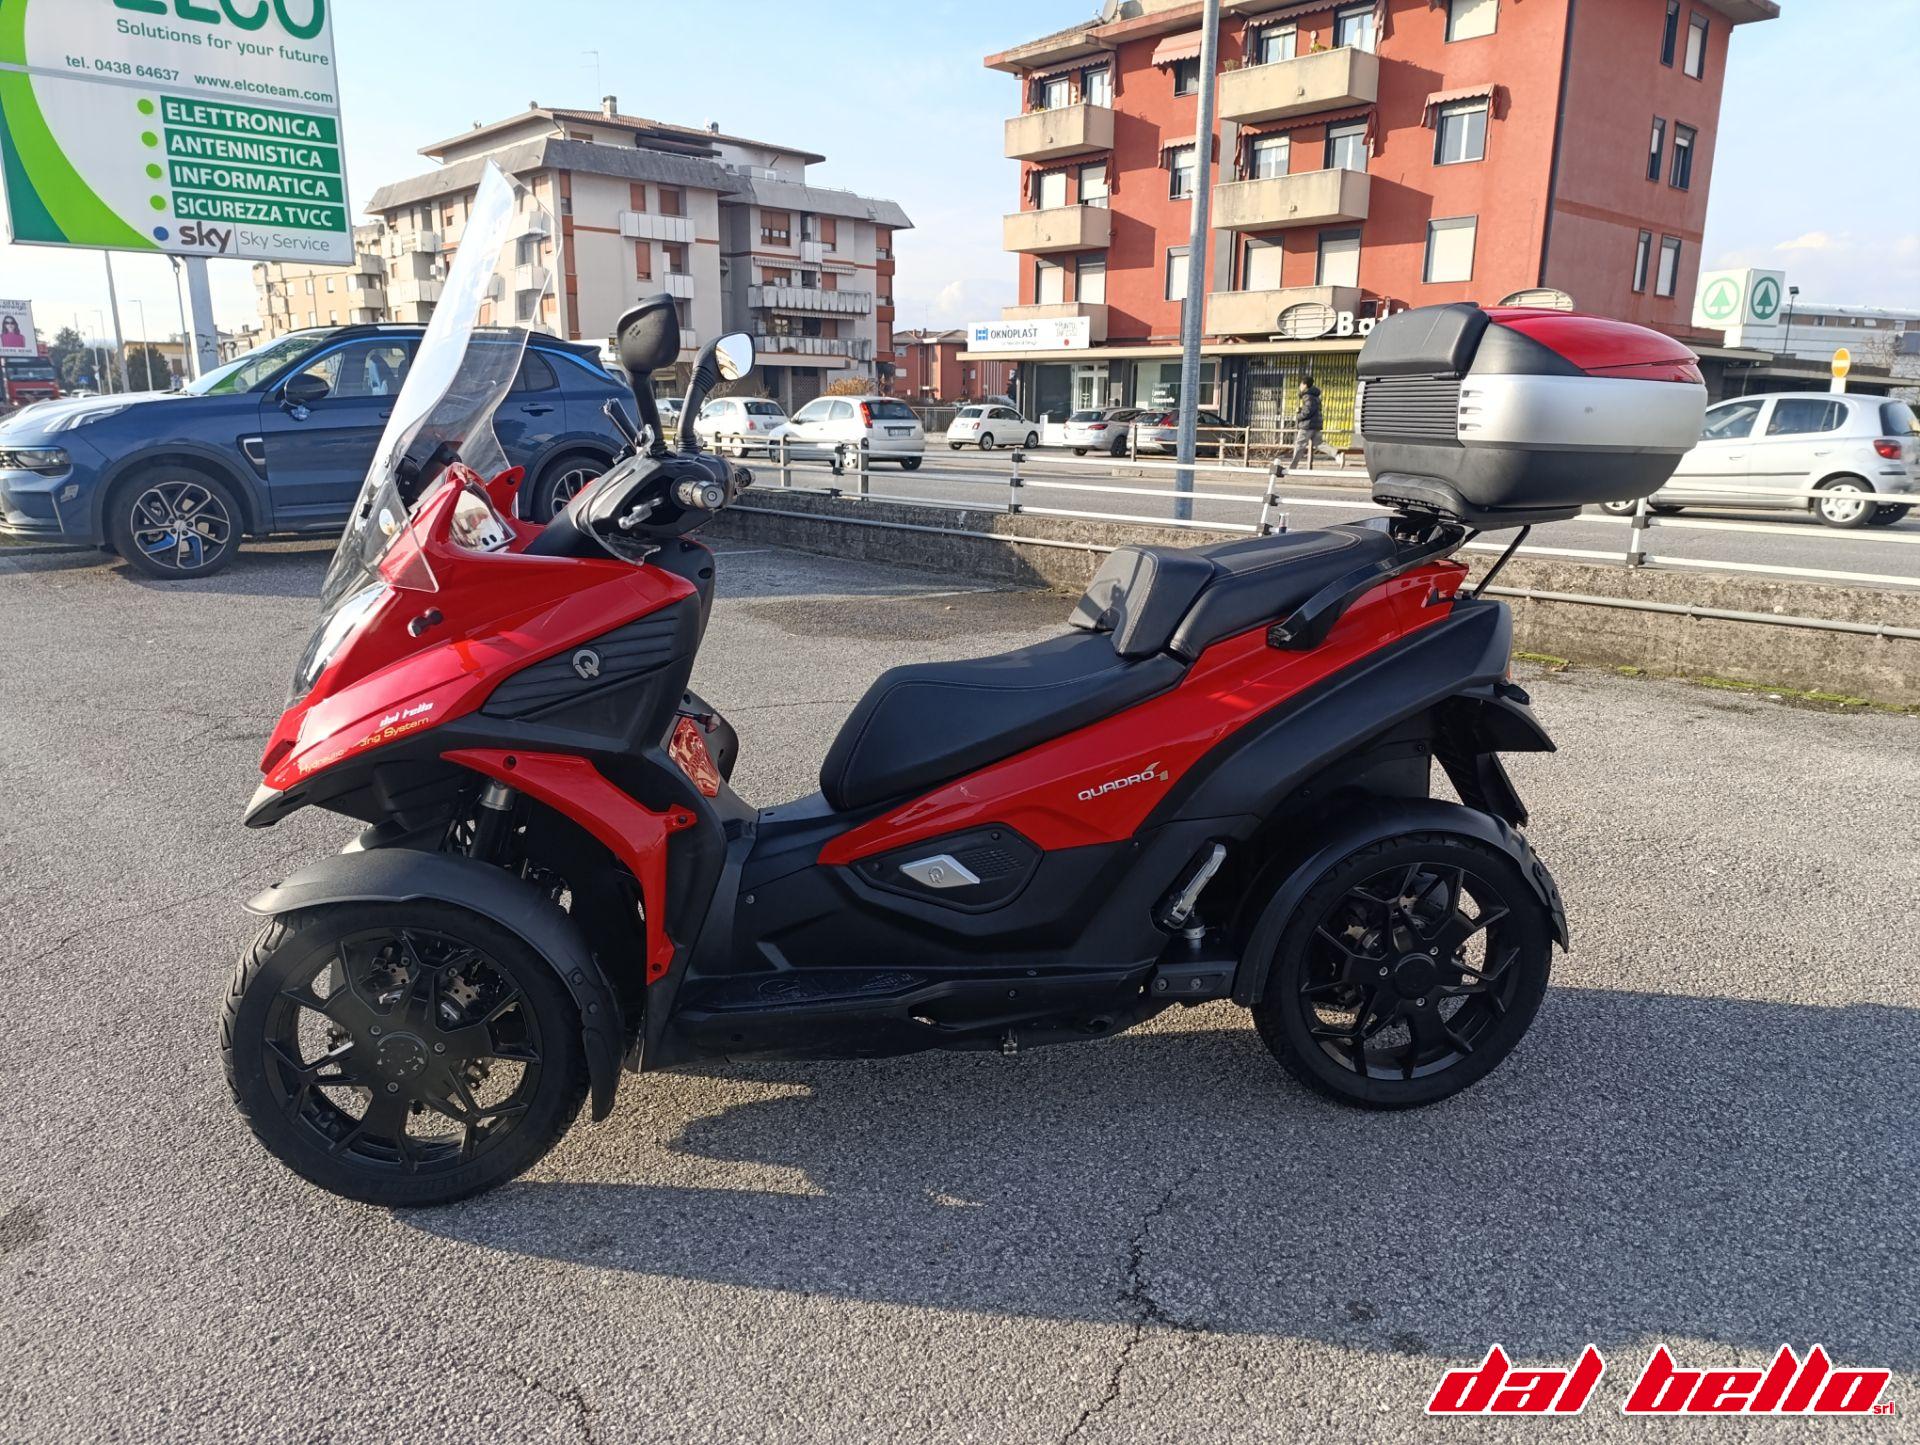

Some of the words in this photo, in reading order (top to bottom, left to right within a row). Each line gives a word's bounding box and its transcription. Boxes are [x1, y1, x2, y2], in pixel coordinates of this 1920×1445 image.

[117, 19, 202, 45] Solutions
[207, 33, 232, 50] for
[237, 41, 274, 56] your
[279, 46, 329, 66] future
[65, 54, 90, 70] tel.
[94, 59, 132, 75] 0438
[135, 64, 180, 82] 64637
[194, 73, 333, 103] www.elcoteam.com
[166, 102, 322, 138] ELETTRONICA
[171, 135, 323, 168] ANTENNISTICA
[174, 165, 330, 197] INFORMATICA
[176, 197, 283, 223] SICUREZZA
[286, 209, 333, 227] TVCC
[179, 221, 232, 253] sky
[240, 230, 269, 250] Sky
[272, 233, 330, 252] Service
[990, 328, 1038, 339] OKNOPLAST
[384, 717, 429, 738] System
